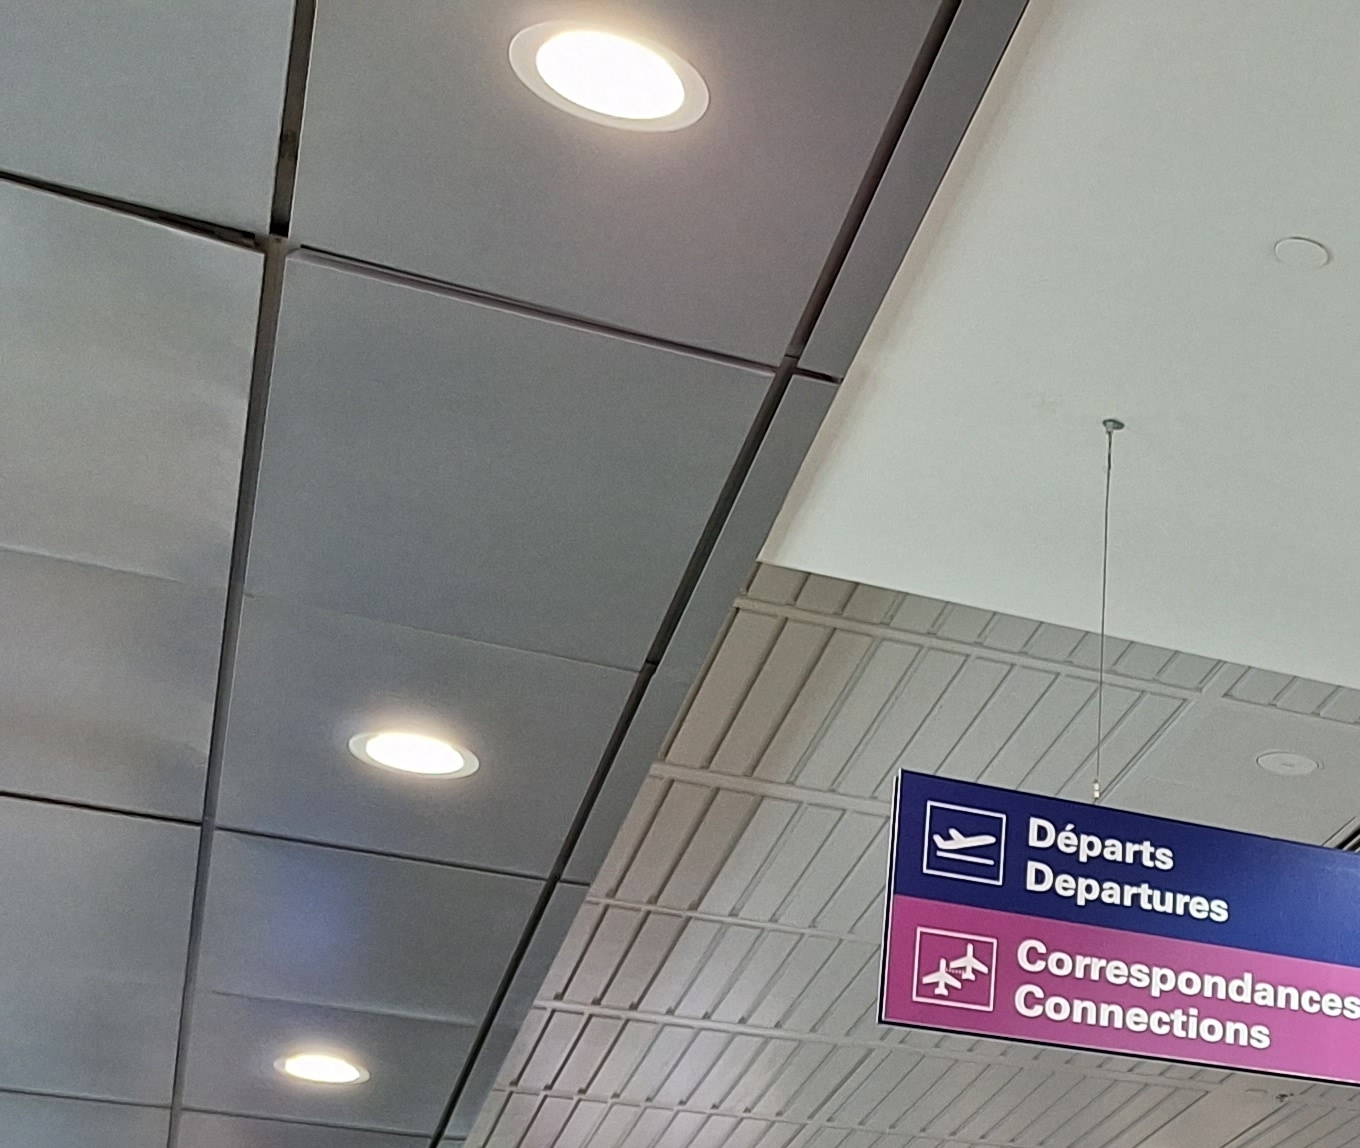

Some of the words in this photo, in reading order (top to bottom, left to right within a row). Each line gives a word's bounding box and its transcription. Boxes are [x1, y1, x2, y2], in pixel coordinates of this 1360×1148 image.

[1027, 814, 1175, 873] Départs
[1025, 861, 1230, 925] Departures
[1013, 983, 1273, 1052] Connections
